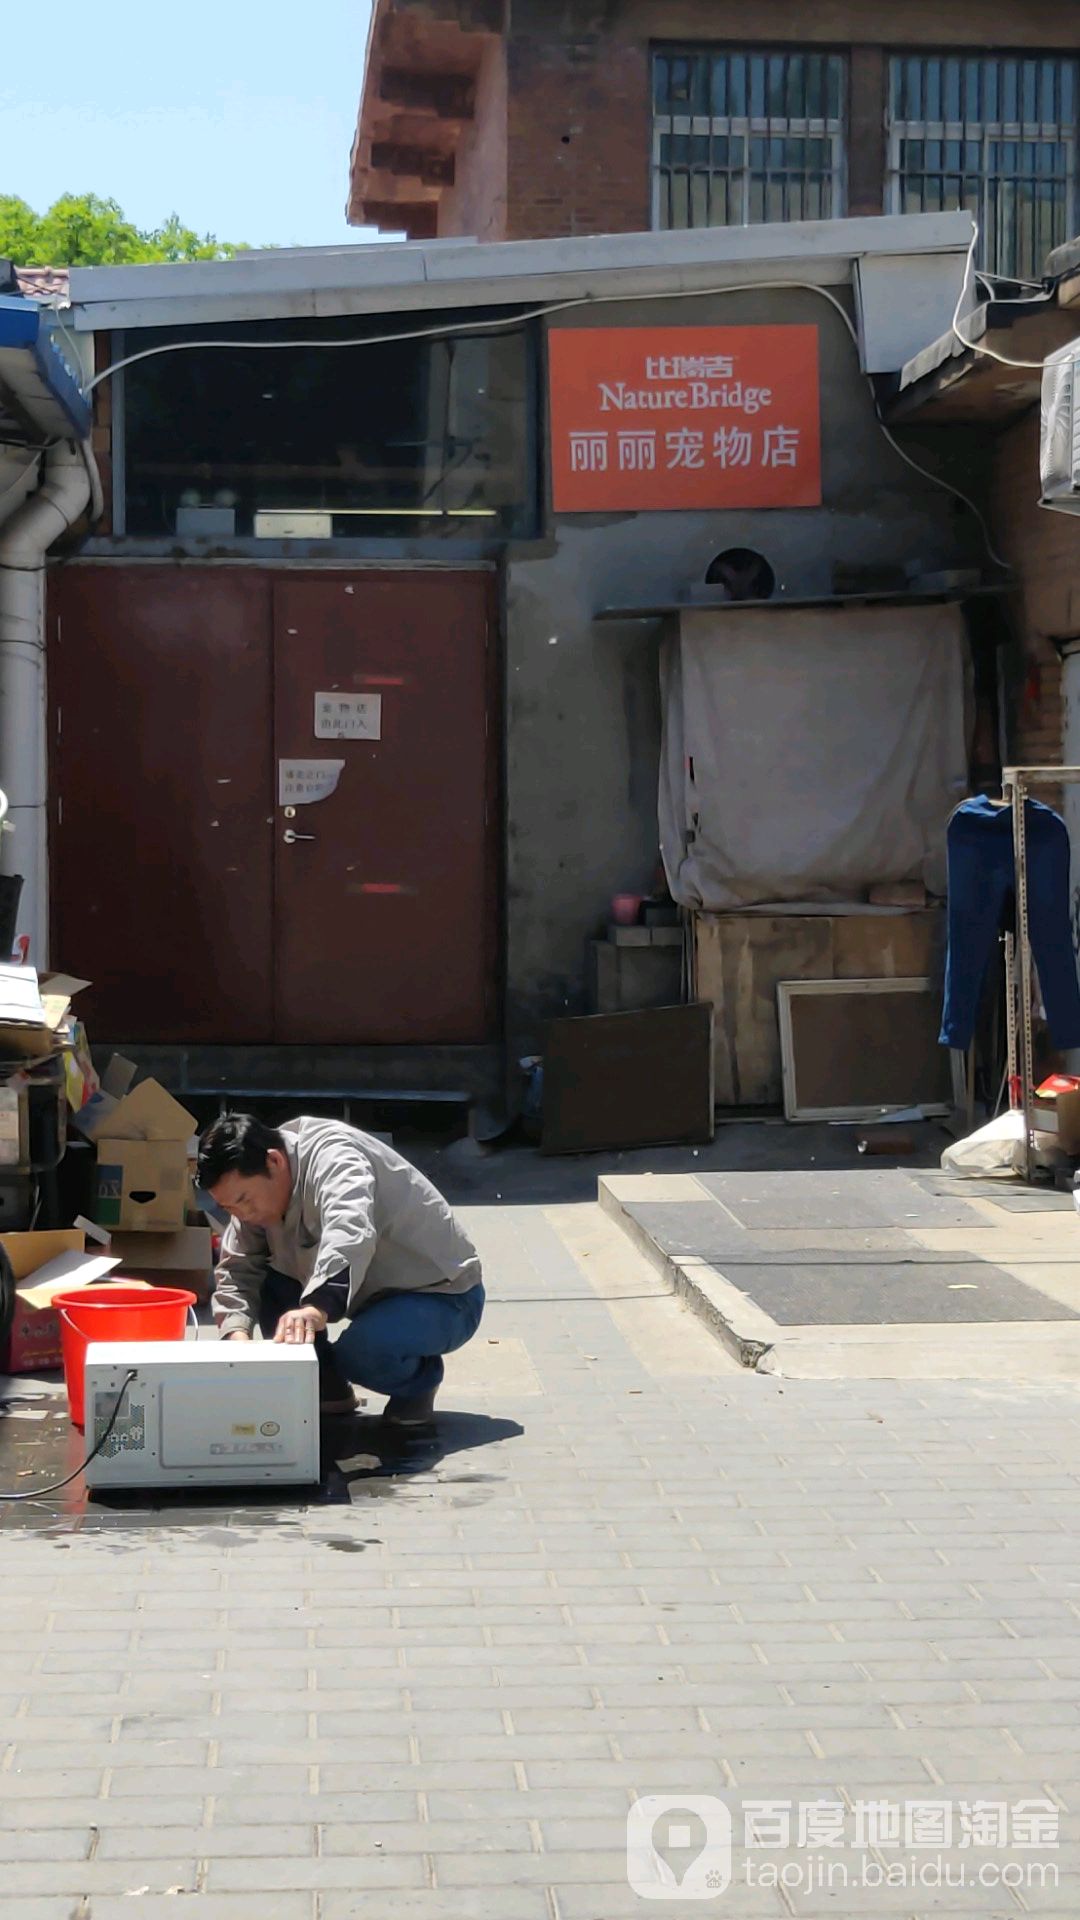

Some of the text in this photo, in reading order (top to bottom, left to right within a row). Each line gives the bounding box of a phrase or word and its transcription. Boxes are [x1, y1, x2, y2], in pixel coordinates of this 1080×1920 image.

[645, 355, 733, 379] 比瑞吉
[597, 381, 772, 414] NatureBridge
[569, 424, 800, 472] 丽丽宠物店
